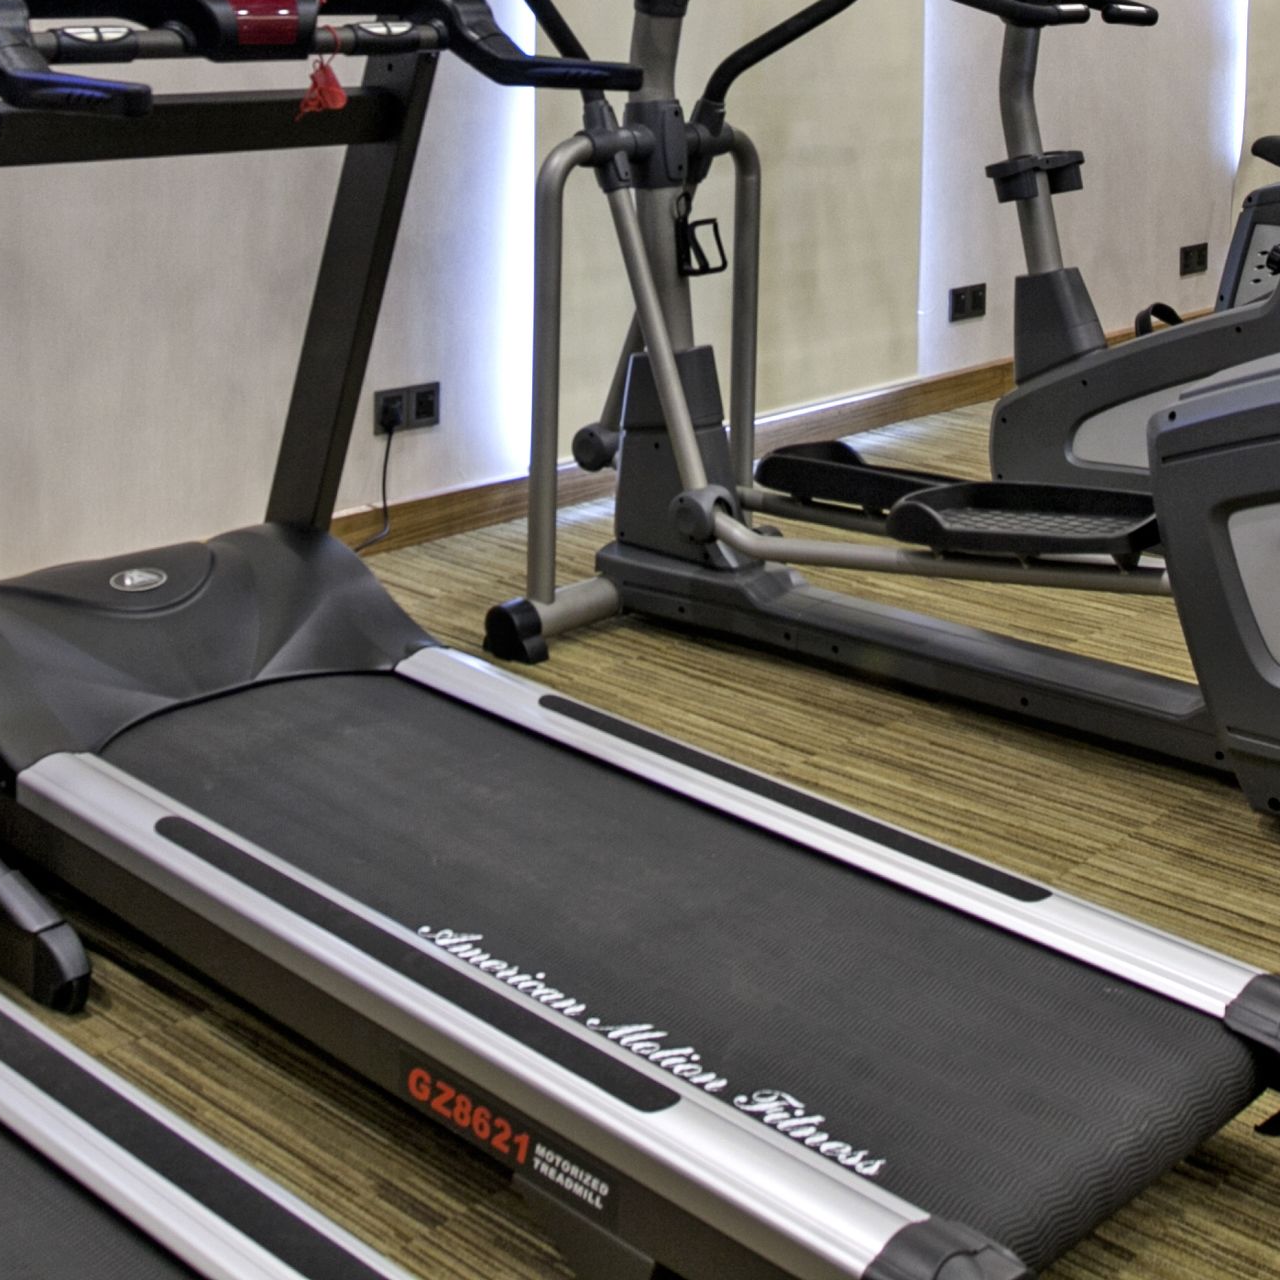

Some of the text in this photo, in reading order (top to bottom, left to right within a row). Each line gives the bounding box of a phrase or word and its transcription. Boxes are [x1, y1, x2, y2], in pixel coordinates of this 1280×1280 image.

[418, 925, 886, 1176] American Motion Fitness
[407, 1067, 530, 1165] GZ8621
[532, 1156, 604, 1211] TREADMILL
[534, 1142, 610, 1198] MOTORIZED
